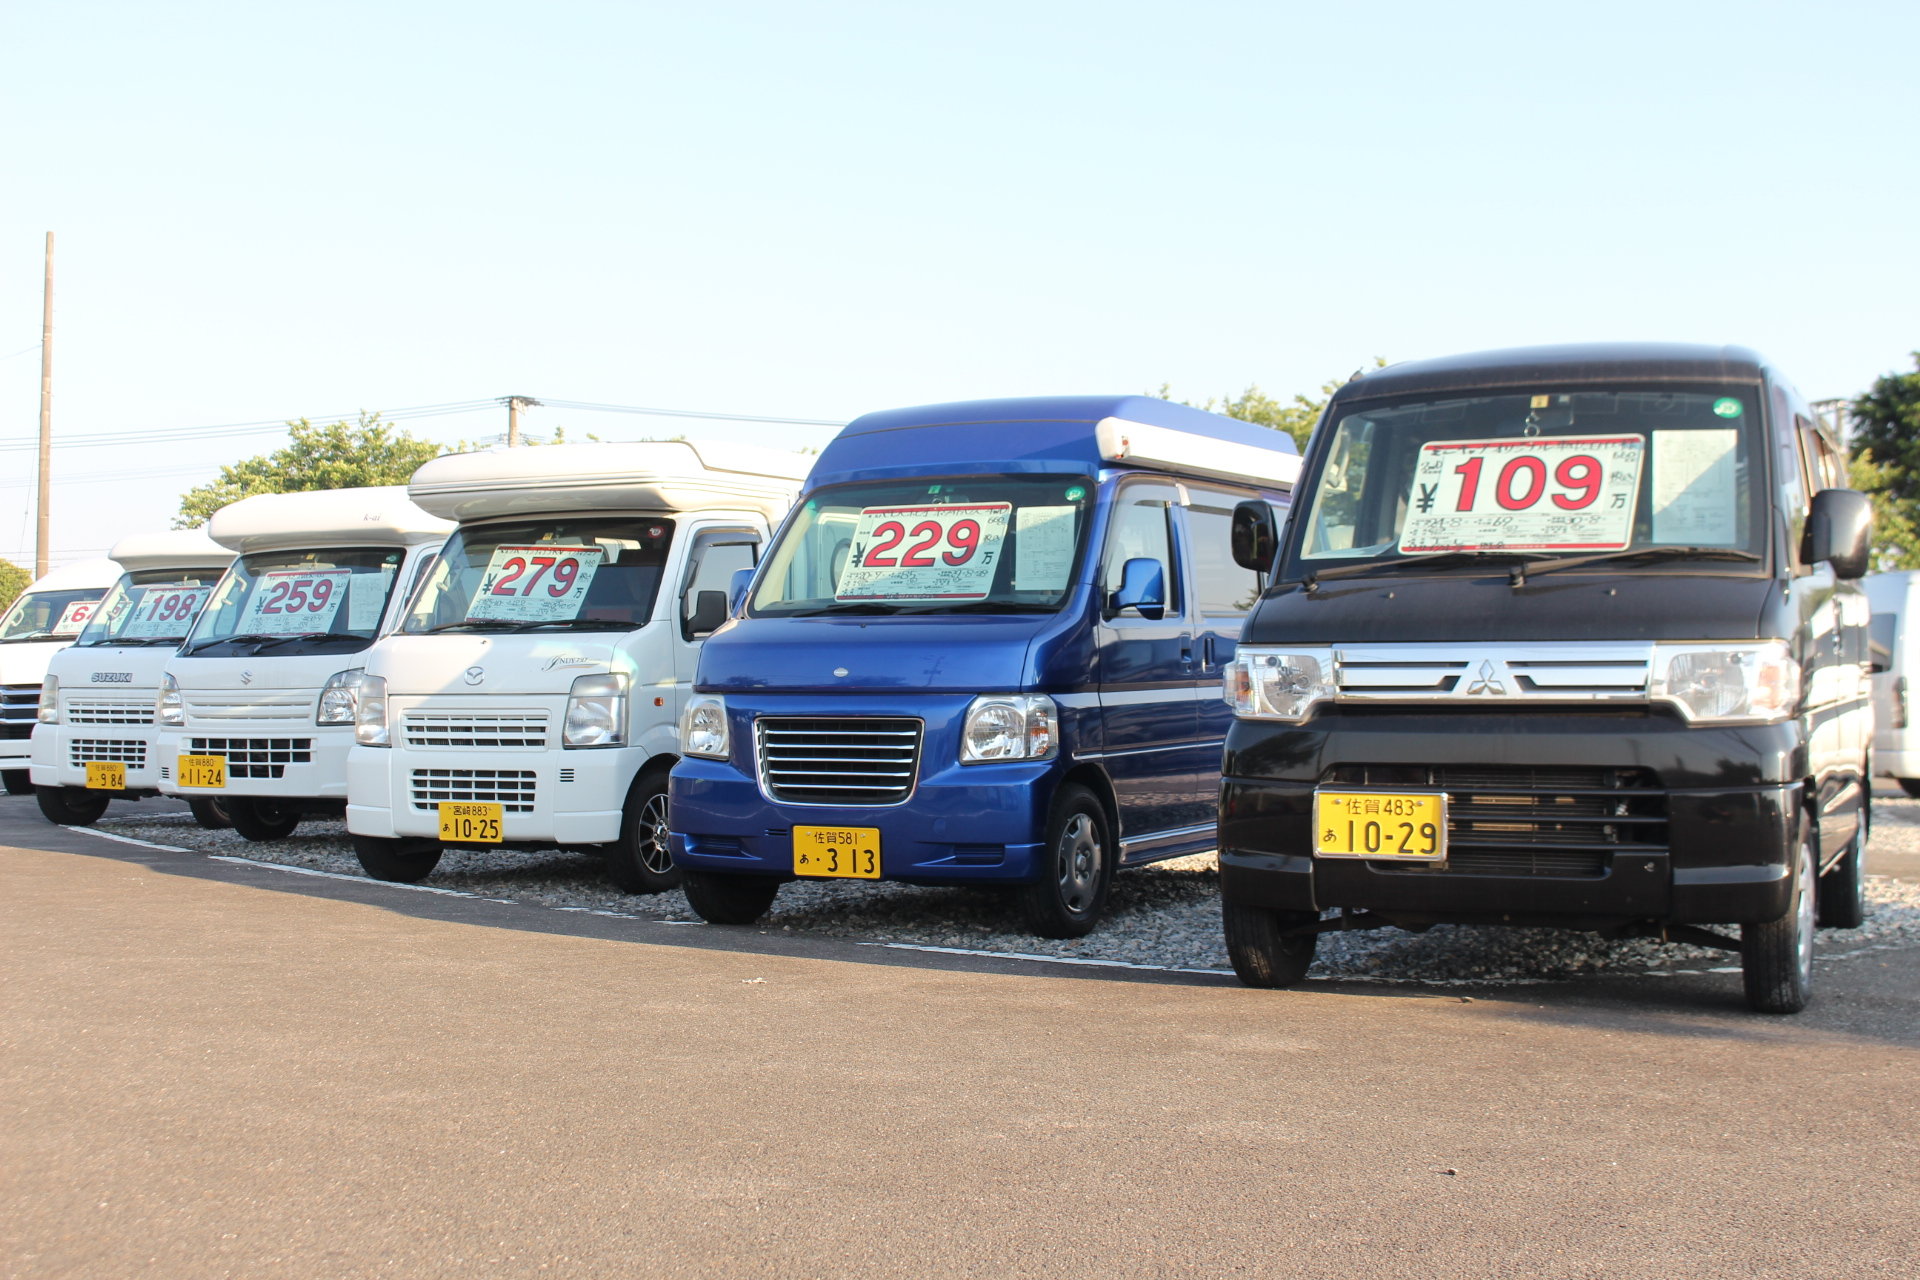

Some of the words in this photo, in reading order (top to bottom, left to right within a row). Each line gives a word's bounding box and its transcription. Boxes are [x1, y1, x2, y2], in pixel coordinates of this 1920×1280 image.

[1416, 483, 1439, 513] ¥
[1454, 454, 1603, 512] 109
[1610, 493, 1628, 509] 万
[851, 542, 868, 568] ¥
[862, 518, 981, 567] 229
[982, 551, 994, 565] 万
[482, 572, 498, 595] ¥
[491, 556, 580, 598] 279
[145, 593, 197, 622] 198
[261, 578, 334, 615] 259
[91, 672, 133, 683] SUZUKI
[189, 768, 222, 785] 11-24
[455, 818, 499, 839] 10-25
[1323, 828, 1337, 843] あ
[1348, 820, 1437, 855] 10-29
[799, 853, 810, 865] あ
